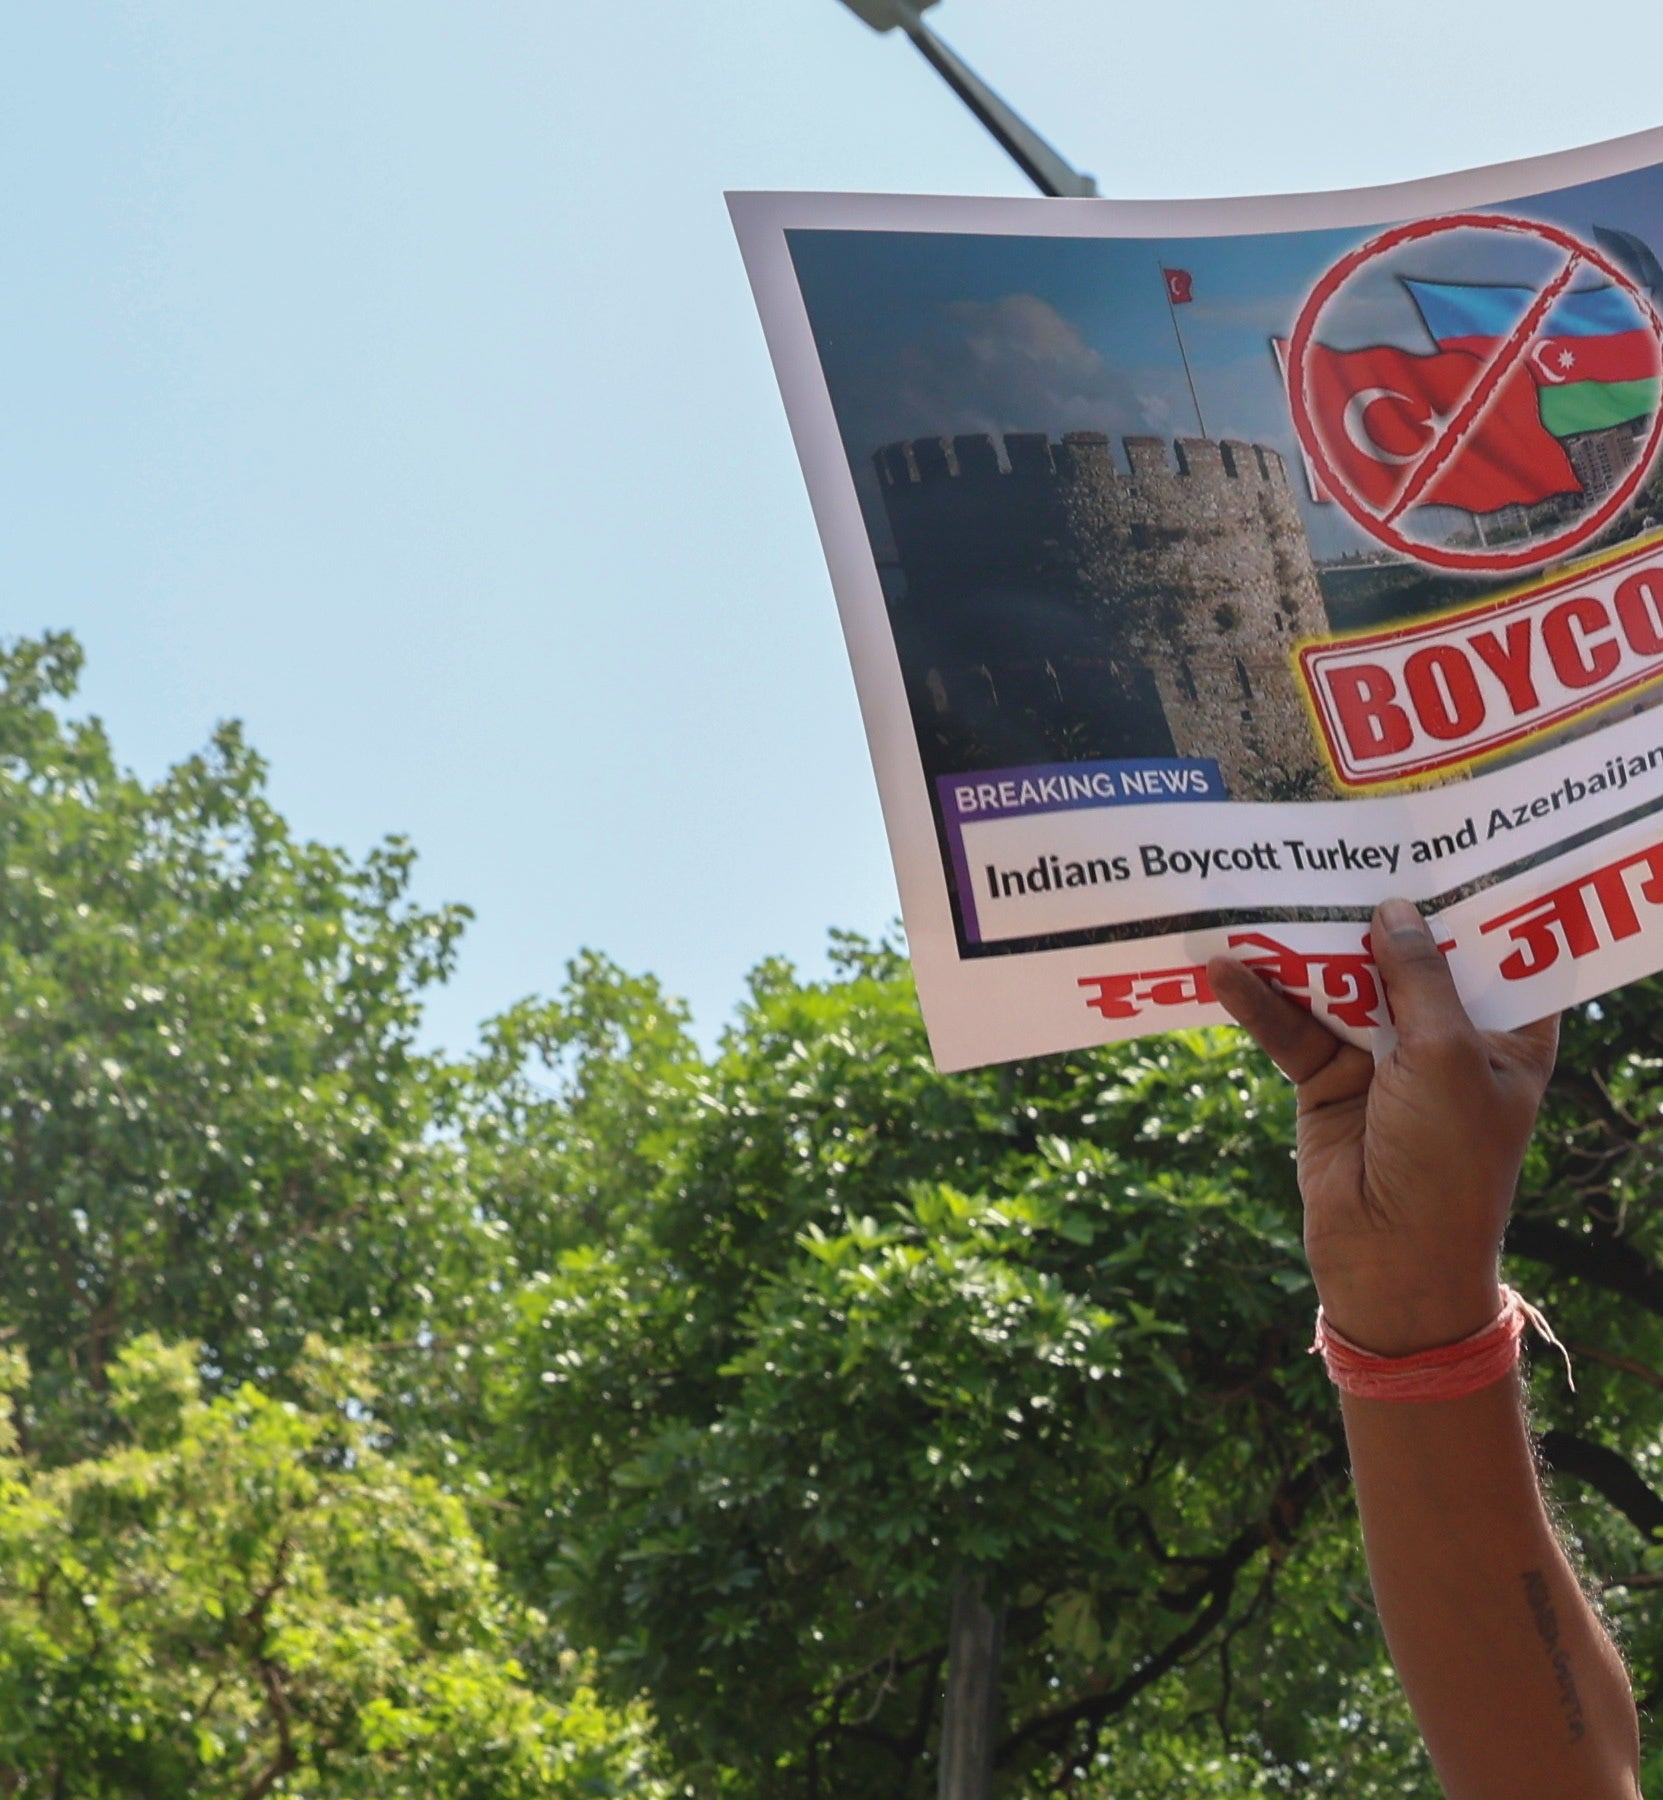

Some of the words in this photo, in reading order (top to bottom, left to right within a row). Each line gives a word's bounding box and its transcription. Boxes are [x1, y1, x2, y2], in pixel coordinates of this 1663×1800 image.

[955, 770, 1115, 814] BREAKING
[1121, 766, 1210, 797] NEWS
[985, 851, 1131, 899] Indians
[1139, 838, 1280, 880] Boycott
[1283, 838, 1401, 874] Turkey
[1410, 819, 1478, 864] and
